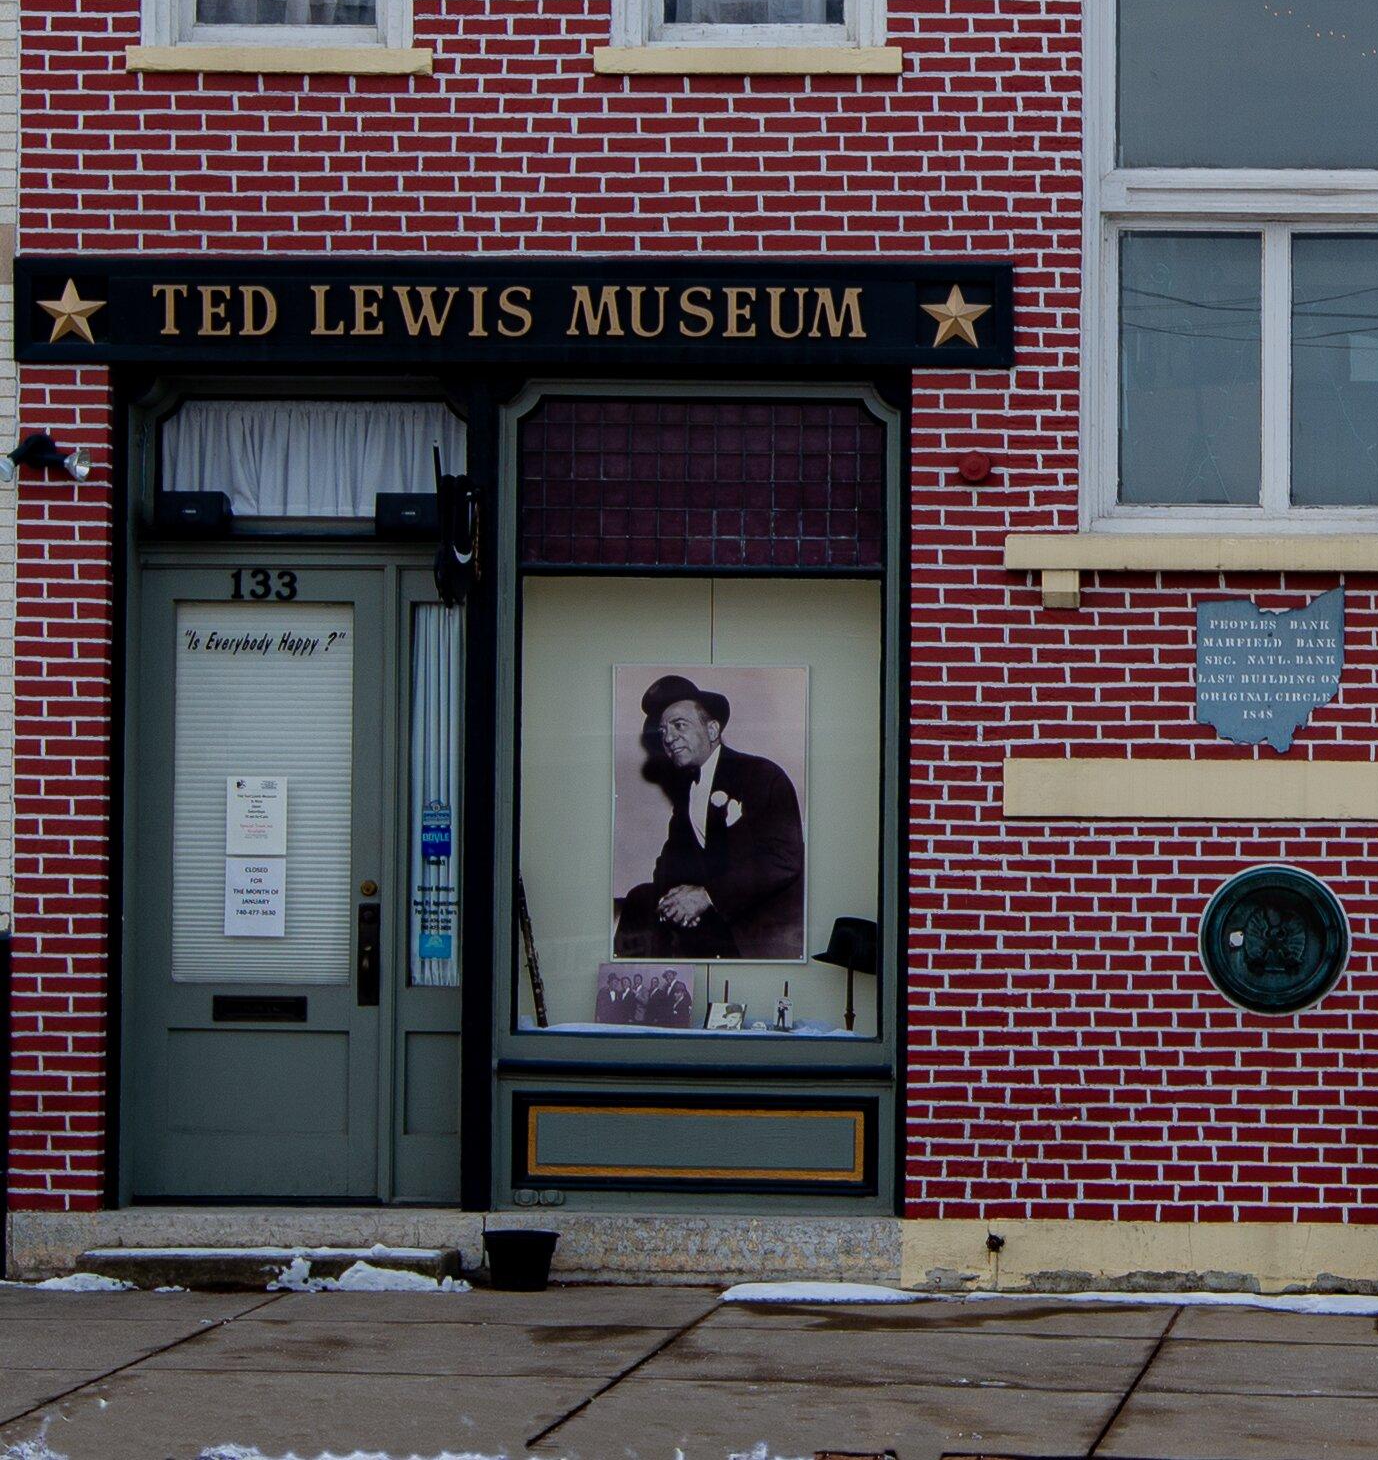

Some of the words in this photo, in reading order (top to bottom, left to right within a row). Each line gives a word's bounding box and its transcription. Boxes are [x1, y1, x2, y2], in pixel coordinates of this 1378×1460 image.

[152, 284, 278, 336] TED
[310, 285, 533, 337] LEWIS
[566, 285, 867, 338] MUSEUM
[230, 568, 299, 601] 133
[1209, 620, 1278, 630] PEOPLES
[1289, 620, 1330, 630] BANK
[205, 631, 273, 655] Everybody
[277, 632, 319, 656] Happy
[1203, 638, 1283, 648] MARFIELD
[1296, 638, 1336, 648] BANK
[1204, 655, 1236, 666] SEC.
[1295, 655, 1336, 665] BANK
[1198, 673, 1236, 684] LAST
[1240, 674, 1316, 684] BUILDING
[1321, 674, 1340, 684] ON
[1200, 692, 1273, 702] ORIGINAL
[1275, 692, 1332, 702] CIRCLE
[1242, 710, 1274, 720] 1848
